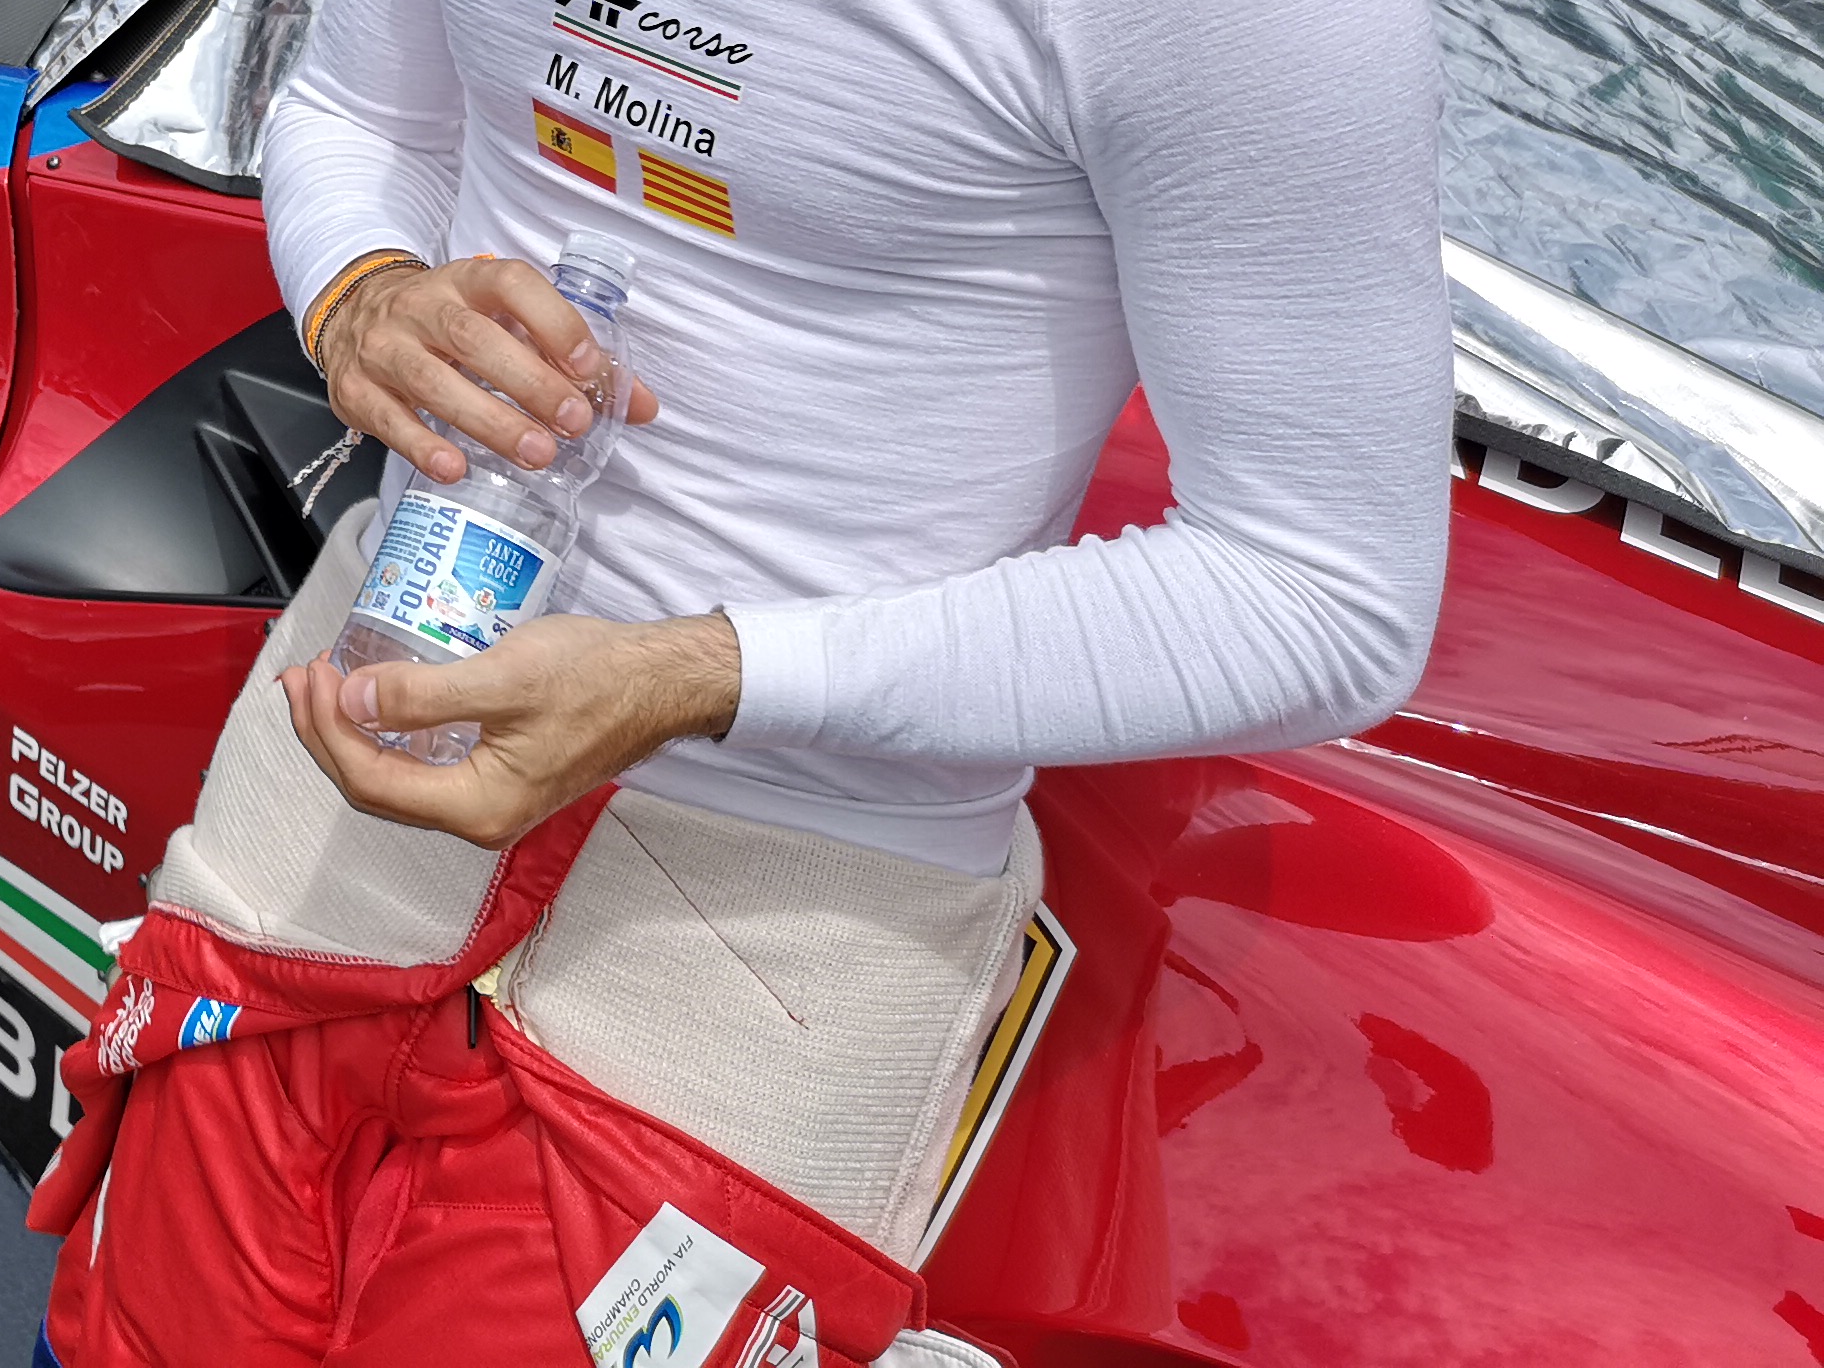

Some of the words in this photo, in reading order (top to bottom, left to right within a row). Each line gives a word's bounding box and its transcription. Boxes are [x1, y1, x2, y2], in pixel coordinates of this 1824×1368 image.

[638, 12, 753, 65] corse
[546, 53, 580, 100] M.
[594, 77, 717, 158] Molina
[391, 506, 462, 626] FOLGARA
[479, 556, 519, 587] CROCE
[485, 538, 524, 571] SANTA
[12, 725, 128, 834] PELZER
[9, 773, 125, 874] GROUP
[673, 1234, 694, 1260] FIA
[637, 1258, 677, 1307] WORLD
[593, 1306, 641, 1365] ENDURA
